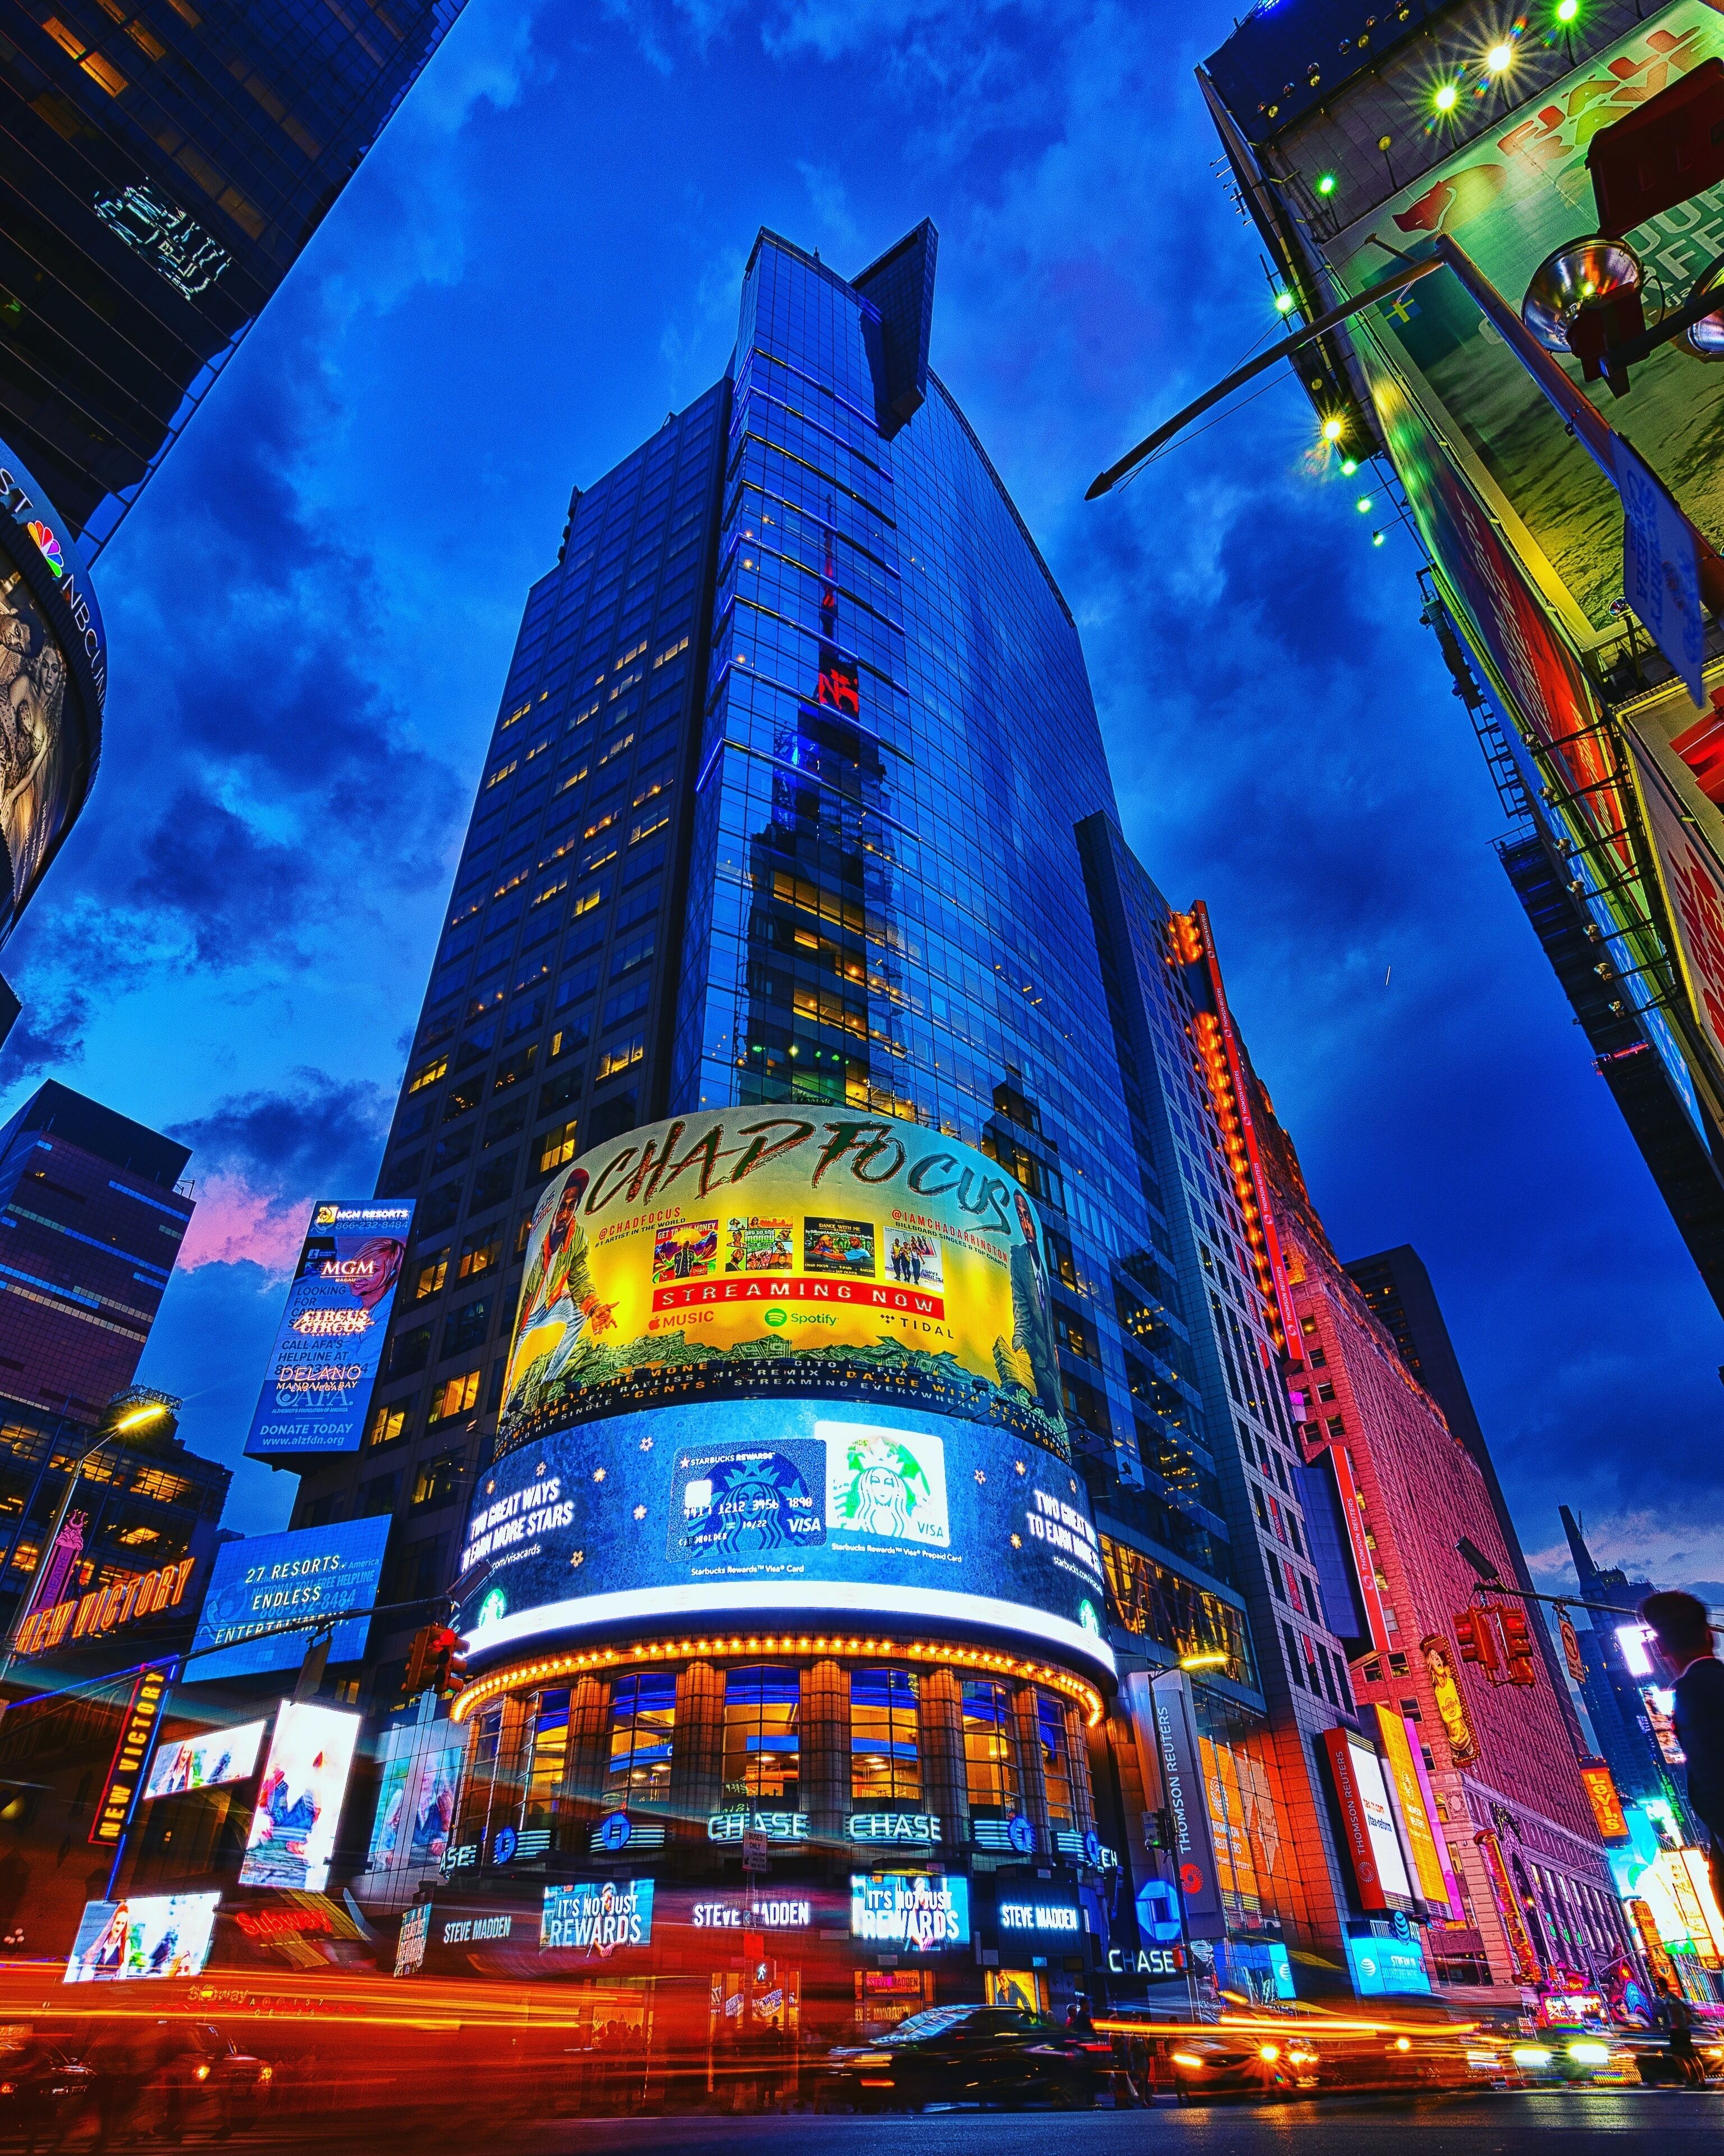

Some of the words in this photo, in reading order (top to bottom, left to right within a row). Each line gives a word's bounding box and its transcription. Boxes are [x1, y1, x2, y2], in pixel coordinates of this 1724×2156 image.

[584, 1120, 815, 1216] CHAD
[811, 1121, 1011, 1236] FOCUS
[598, 1207, 681, 1240] @CHADFOCUS
[605, 1231, 629, 1244] ARTIST
[641, 1224, 657, 1233] THE
[658, 1217, 686, 1228] WORLD
[657, 1230, 670, 1240] GET
[694, 1222, 717, 1232] MONEY
[895, 1221, 938, 1237] BILLBOARD
[974, 1248, 986, 1256] TOP
[986, 1253, 1008, 1269] CHARTS
[321, 1260, 374, 1275] MGM
[294, 1298, 317, 1307] FOR
[297, 1286, 346, 1296] LOOKING
[662, 1283, 851, 1305] STREAMING
[872, 1289, 932, 1313] NOW
[664, 1310, 714, 1328] MUSIC
[790, 1313, 837, 1326] Spotify
[900, 1317, 955, 1340] TIDAL
[278, 1351, 331, 1362] HELPLINE
[333, 1351, 349, 1361] AT
[282, 1340, 310, 1350] CALL
[310, 1340, 344, 1349] AFA'S
[280, 1366, 362, 1382] DELANO
[561, 1398, 612, 1420] SINGLE
[734, 1378, 849, 1387] STREAMING
[989, 1409, 1028, 1432] STAY
[932, 1383, 980, 1403] WITH
[260, 1425, 310, 1435] DONATE
[313, 1423, 353, 1434] TODAY
[263, 1435, 344, 1446] www.alzfdn.org
[690, 1454, 735, 1467] STARBUCKS
[521, 1477, 561, 1512] WAYS
[1034, 1489, 1060, 1520] TWO
[492, 1516, 527, 1551] MORE
[526, 1500, 575, 1538] STARS
[786, 1517, 822, 1533] VISA
[1346, 1498, 1361, 1532] REUTERS
[917, 1521, 944, 1538] VISA
[1026, 1511, 1045, 1540] TO
[1045, 1519, 1073, 1552] EARN
[491, 1543, 542, 1570] com/visacards
[831, 1542, 866, 1552] Starbucks
[921, 1550, 946, 1561] Prepaid
[946, 1553, 962, 1563] Card
[1355, 1533, 1370, 1572] THOMSON
[245, 1567, 266, 1584] 27
[271, 1554, 345, 1580] RESORTS.
[336, 1570, 375, 1586] HELPLINE
[690, 1566, 726, 1576] Starbucks
[786, 1564, 804, 1573] Card
[15, 1600, 79, 1653] NEW
[72, 1557, 195, 1639] VICTORY
[252, 1585, 322, 1611] ENDLESS
[1156, 1705, 1178, 1773] REUTERS
[99, 1784, 131, 1837] NEW
[118, 1673, 164, 1771] VICTORY
[1335, 1750, 1352, 1797] REUTERS
[707, 1812, 809, 1840] CHASE
[849, 1812, 943, 1842] CHASE
[1167, 1776, 1191, 1854] THOMSON
[1346, 1800, 1366, 1855] THOMSON
[748, 1833, 763, 1841] BUSES
[557, 1898, 580, 1917] IT'S
[583, 1897, 607, 1915] NOT
[610, 1894, 639, 1913] JUST
[867, 1890, 892, 1909] IT'S
[234, 1908, 332, 1939] Subway
[693, 1903, 741, 1927] STEVE
[862, 1910, 961, 1939] REWARDS
[1002, 1905, 1034, 1928] STEVE
[1036, 1907, 1078, 1930] MADDEN
[443, 1918, 472, 1944] STEVE
[472, 1916, 511, 1941] MADDEN
[549, 1914, 642, 1946] REWARDS
[1108, 1949, 1177, 1972] CHASE
[188, 1984, 249, 2004] Sway
[891, 1976, 918, 1987] MADDEN
